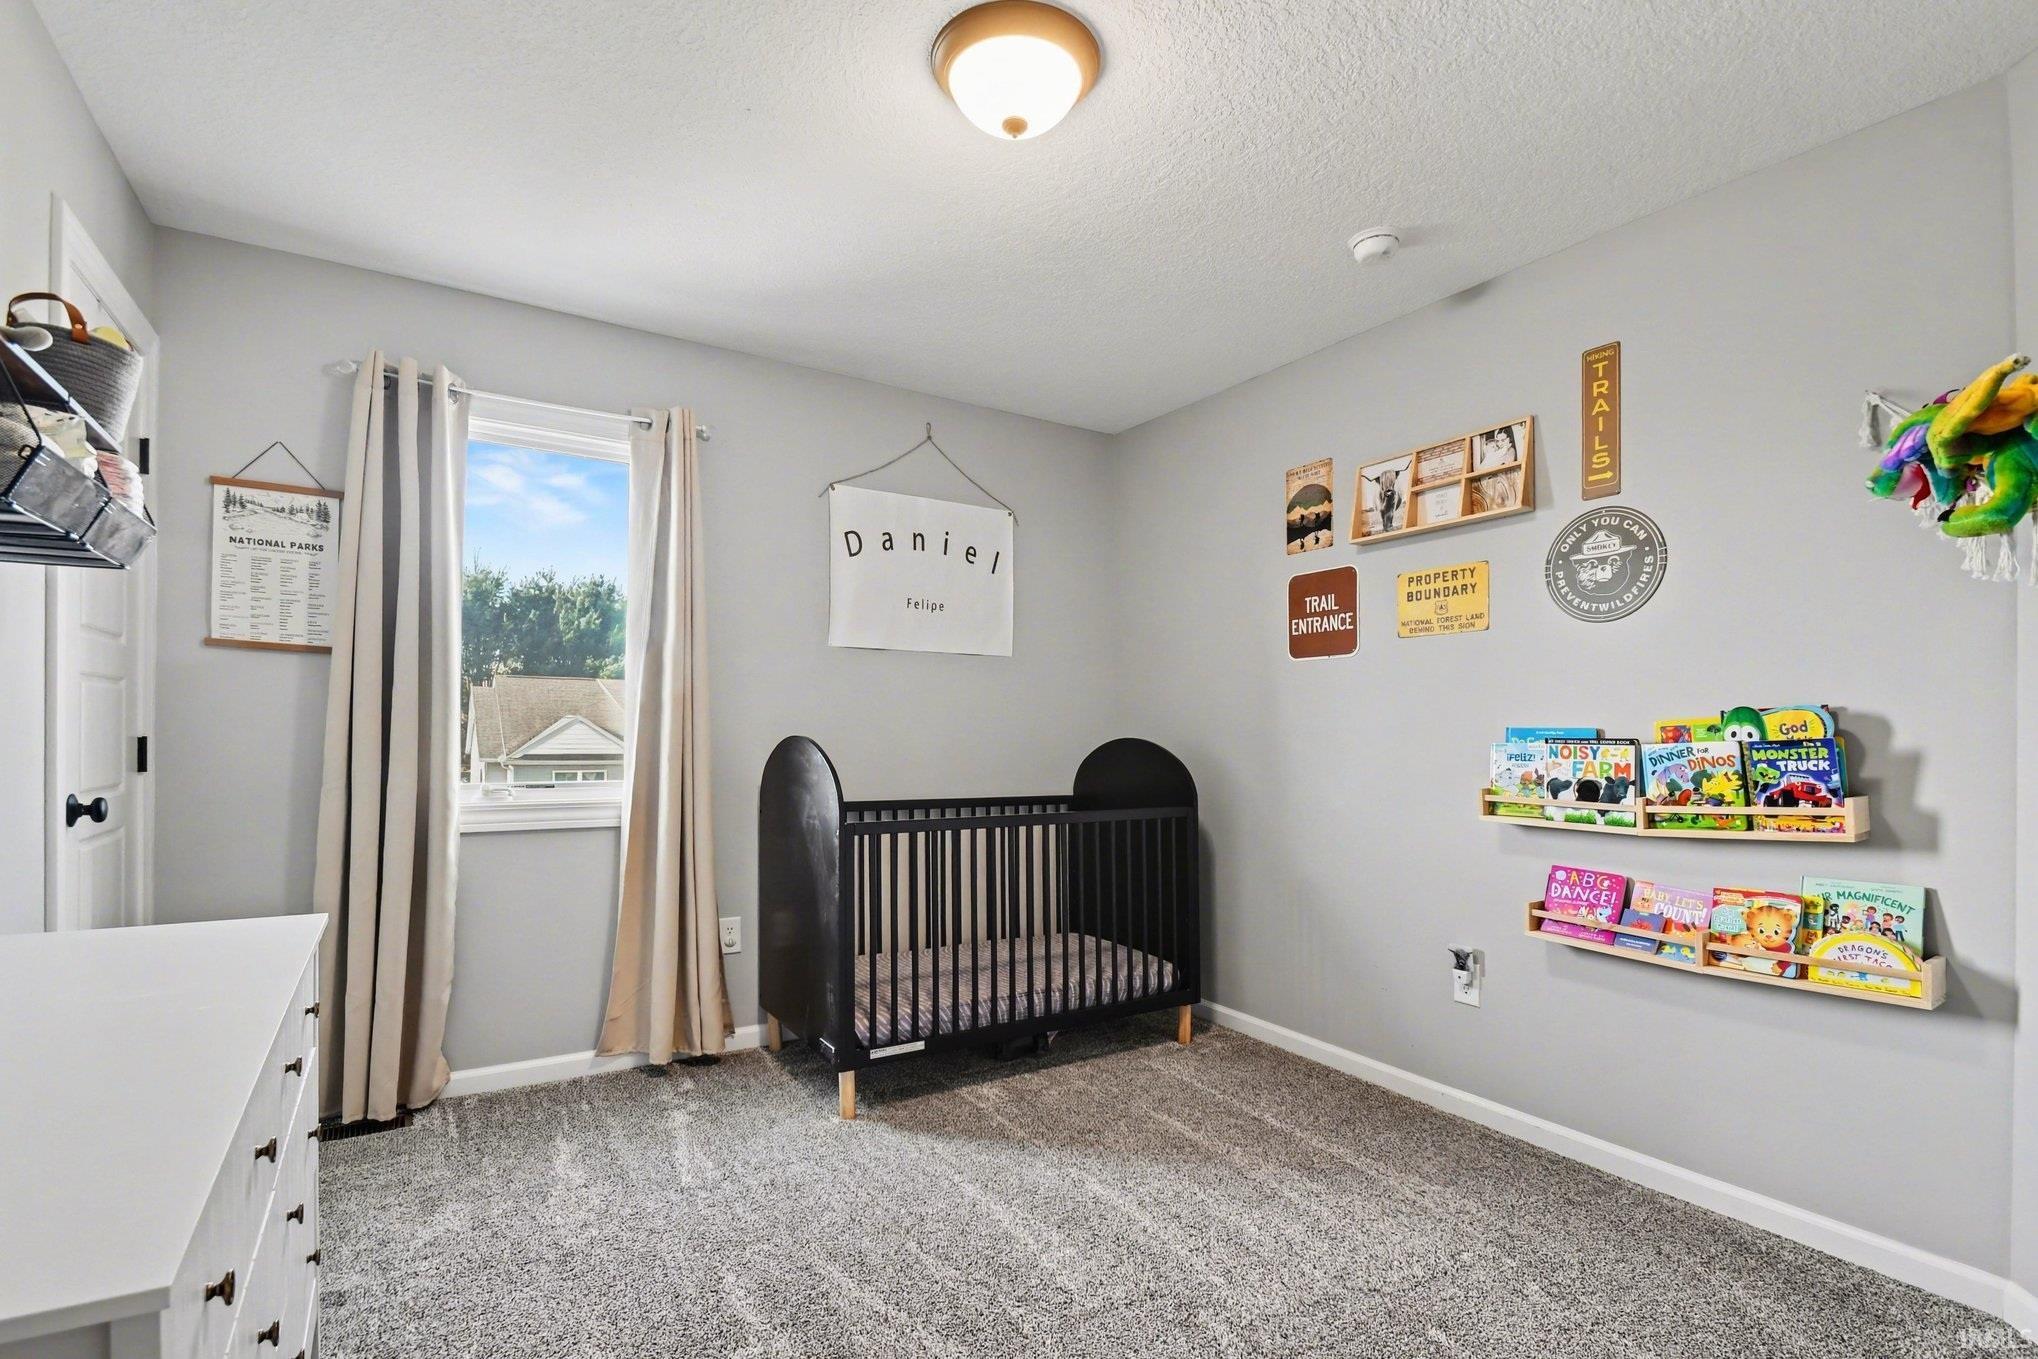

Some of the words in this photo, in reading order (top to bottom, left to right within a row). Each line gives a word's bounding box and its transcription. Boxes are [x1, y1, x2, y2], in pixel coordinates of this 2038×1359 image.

[1586, 349, 1614, 362] HIKING
[1591, 361, 1611, 469] TRAILS
[229, 535, 286, 549] NATIONAL
[290, 541, 325, 552] PARKS
[1560, 523, 1588, 553] ONLY
[1591, 516, 1620, 528] YOU
[1622, 520, 1648, 541] CAN
[844, 530, 1000, 574] Daniel
[1407, 566, 1477, 588] PROPERTY
[1406, 582, 1477, 602] BOUNDARY
[906, 597, 945, 613] Felipe
[1304, 593, 1339, 614] TRAIL
[1291, 612, 1354, 636] ENTRANCE
[1401, 618, 1434, 627] NATIONAL
[1436, 614, 1462, 624] FOREST
[1465, 612, 1485, 621] LAND
[1779, 720, 1808, 735] God
[1548, 745, 1601, 761] NOISY
[1751, 747, 1829, 761] MONSTER
[1572, 761, 1632, 781] FARM
[1776, 760, 1831, 772] TRUCK
[1550, 882, 1617, 907] DANCE!
[1836, 890, 1916, 915] MAGNIFICENT
[1654, 902, 1708, 925] COUNT!
[1838, 944, 1889, 960] DRAGON'S
